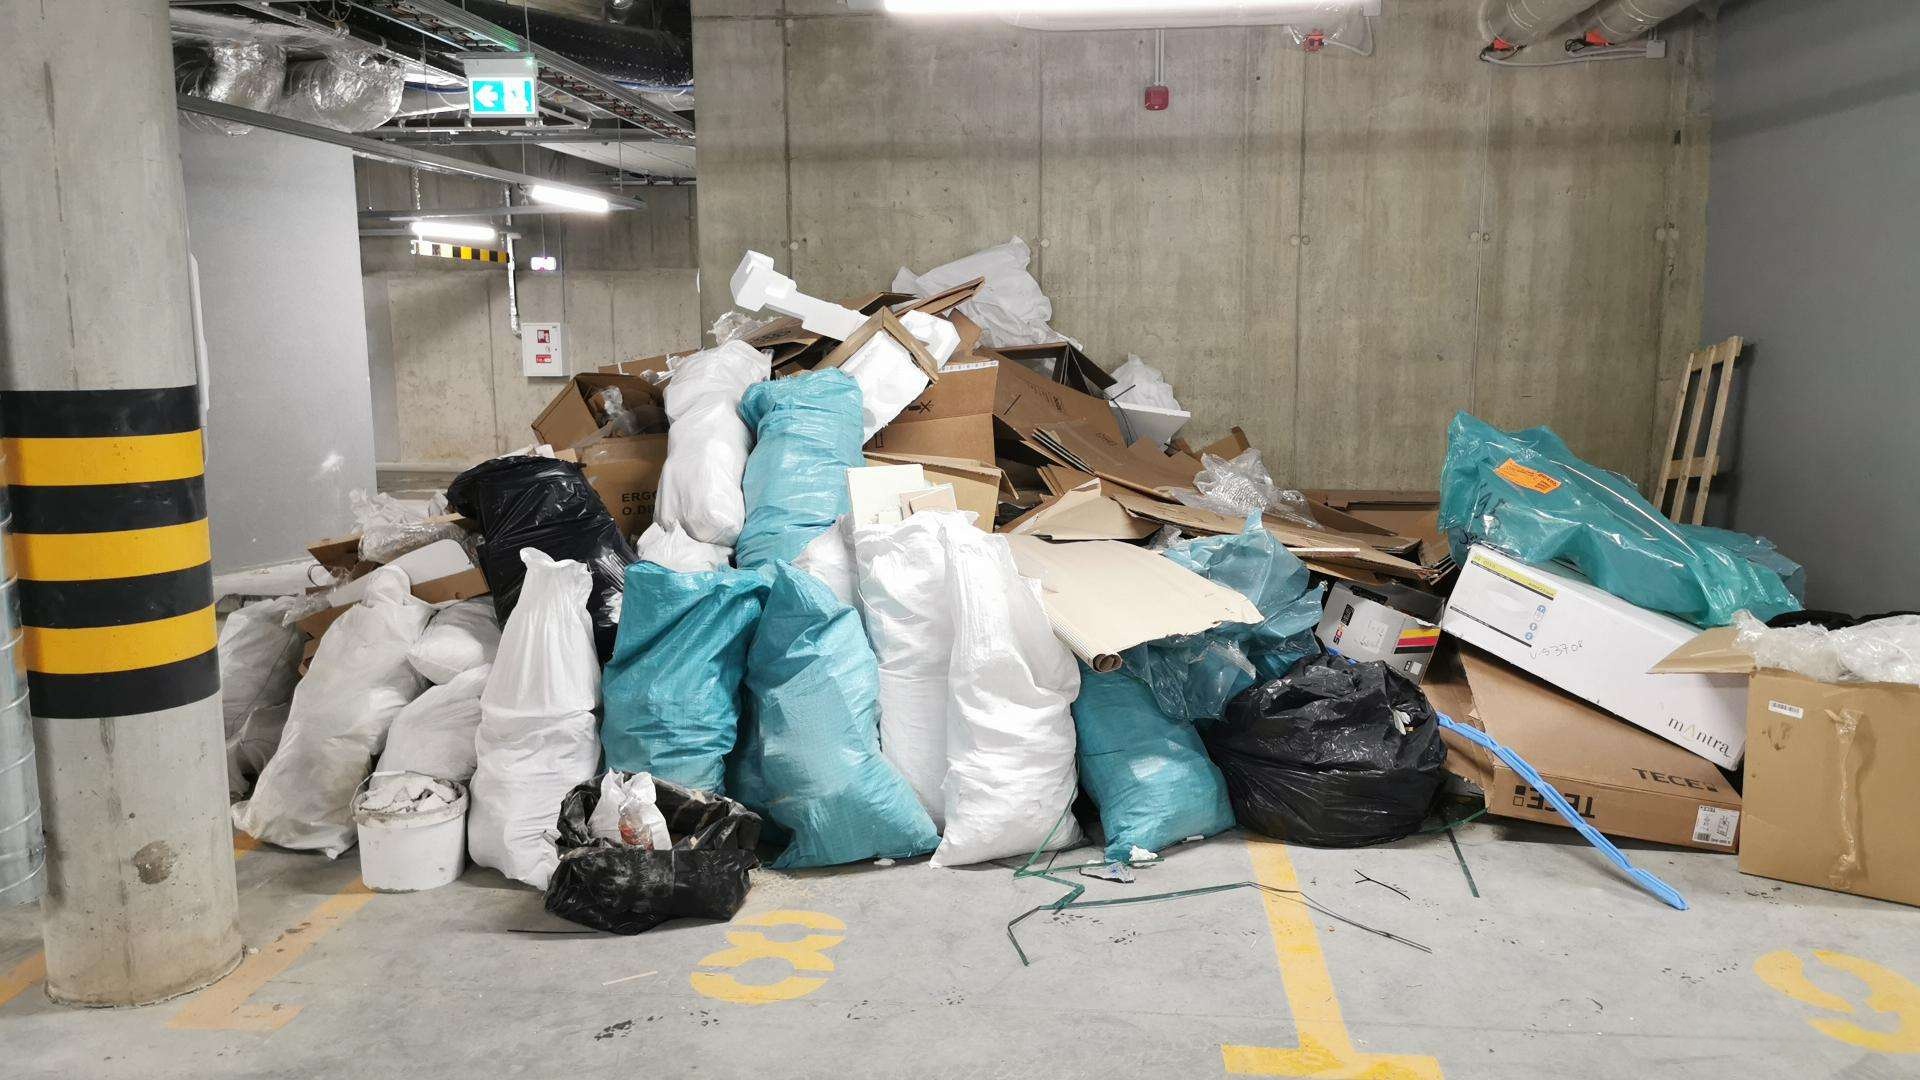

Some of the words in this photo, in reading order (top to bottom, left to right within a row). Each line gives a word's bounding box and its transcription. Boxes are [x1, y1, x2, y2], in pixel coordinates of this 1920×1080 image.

[1632, 767, 1704, 791] TECE
[1526, 786, 1596, 819] TEE
[689, 909, 847, 1005] 8
